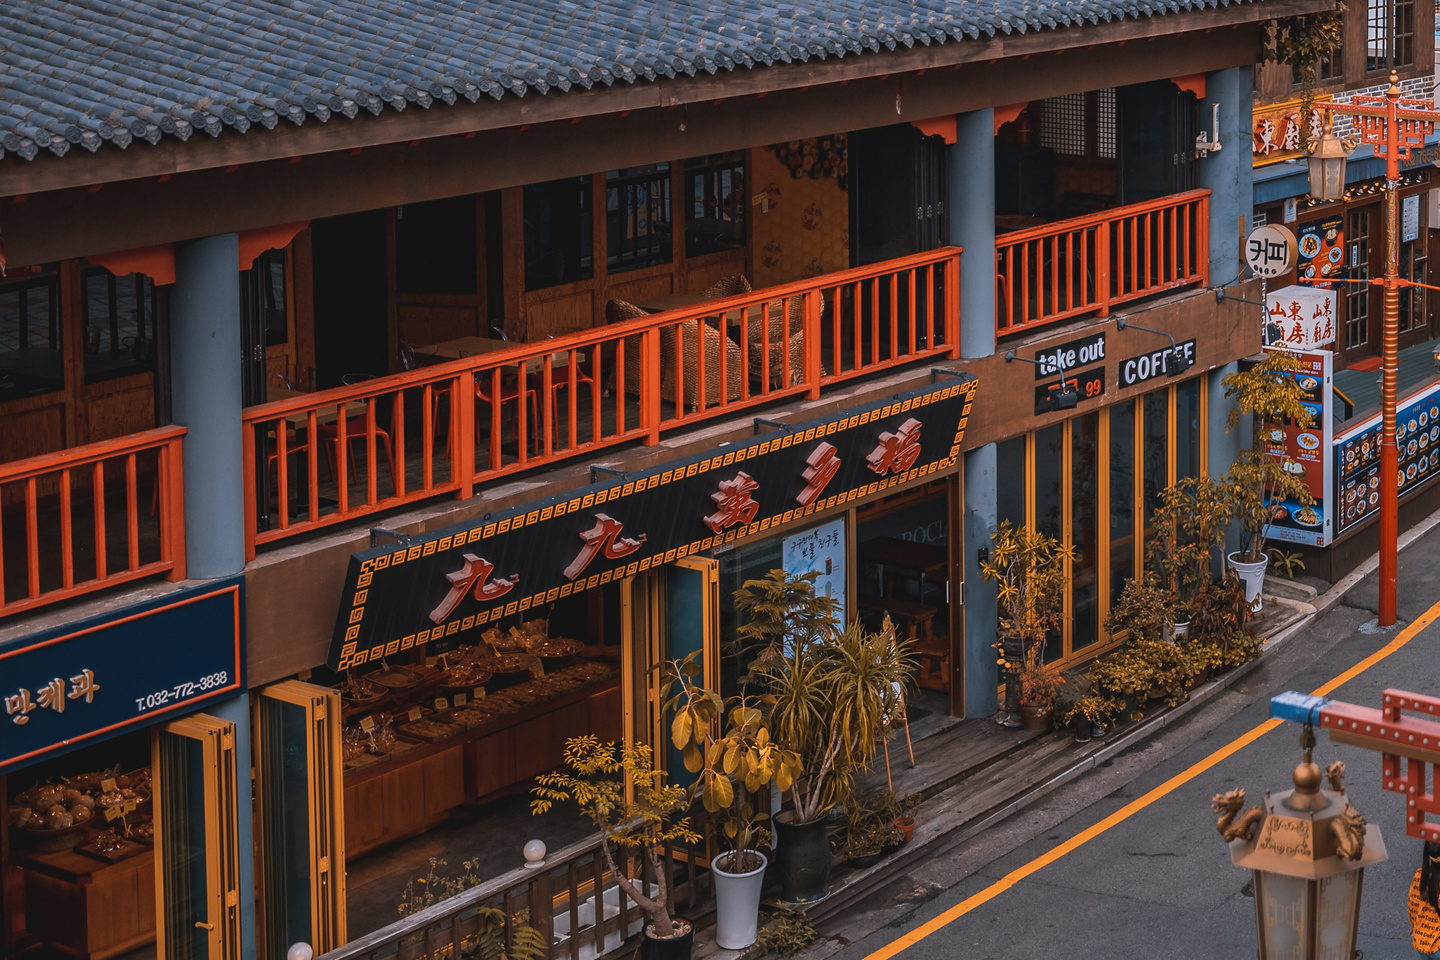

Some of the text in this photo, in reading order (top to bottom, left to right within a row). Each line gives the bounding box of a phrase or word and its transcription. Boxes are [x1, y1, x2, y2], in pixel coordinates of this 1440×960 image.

[1250, 238, 1287, 266] 커피
[1270, 301, 1304, 322] 山東
[1312, 296, 1332, 320] 山東
[1038, 337, 1105, 376] take out
[1085, 378, 1101, 398] 99
[429, 417, 922, 625] 九九萬多福
[135, 670, 228, 712] T.032-772-3838
